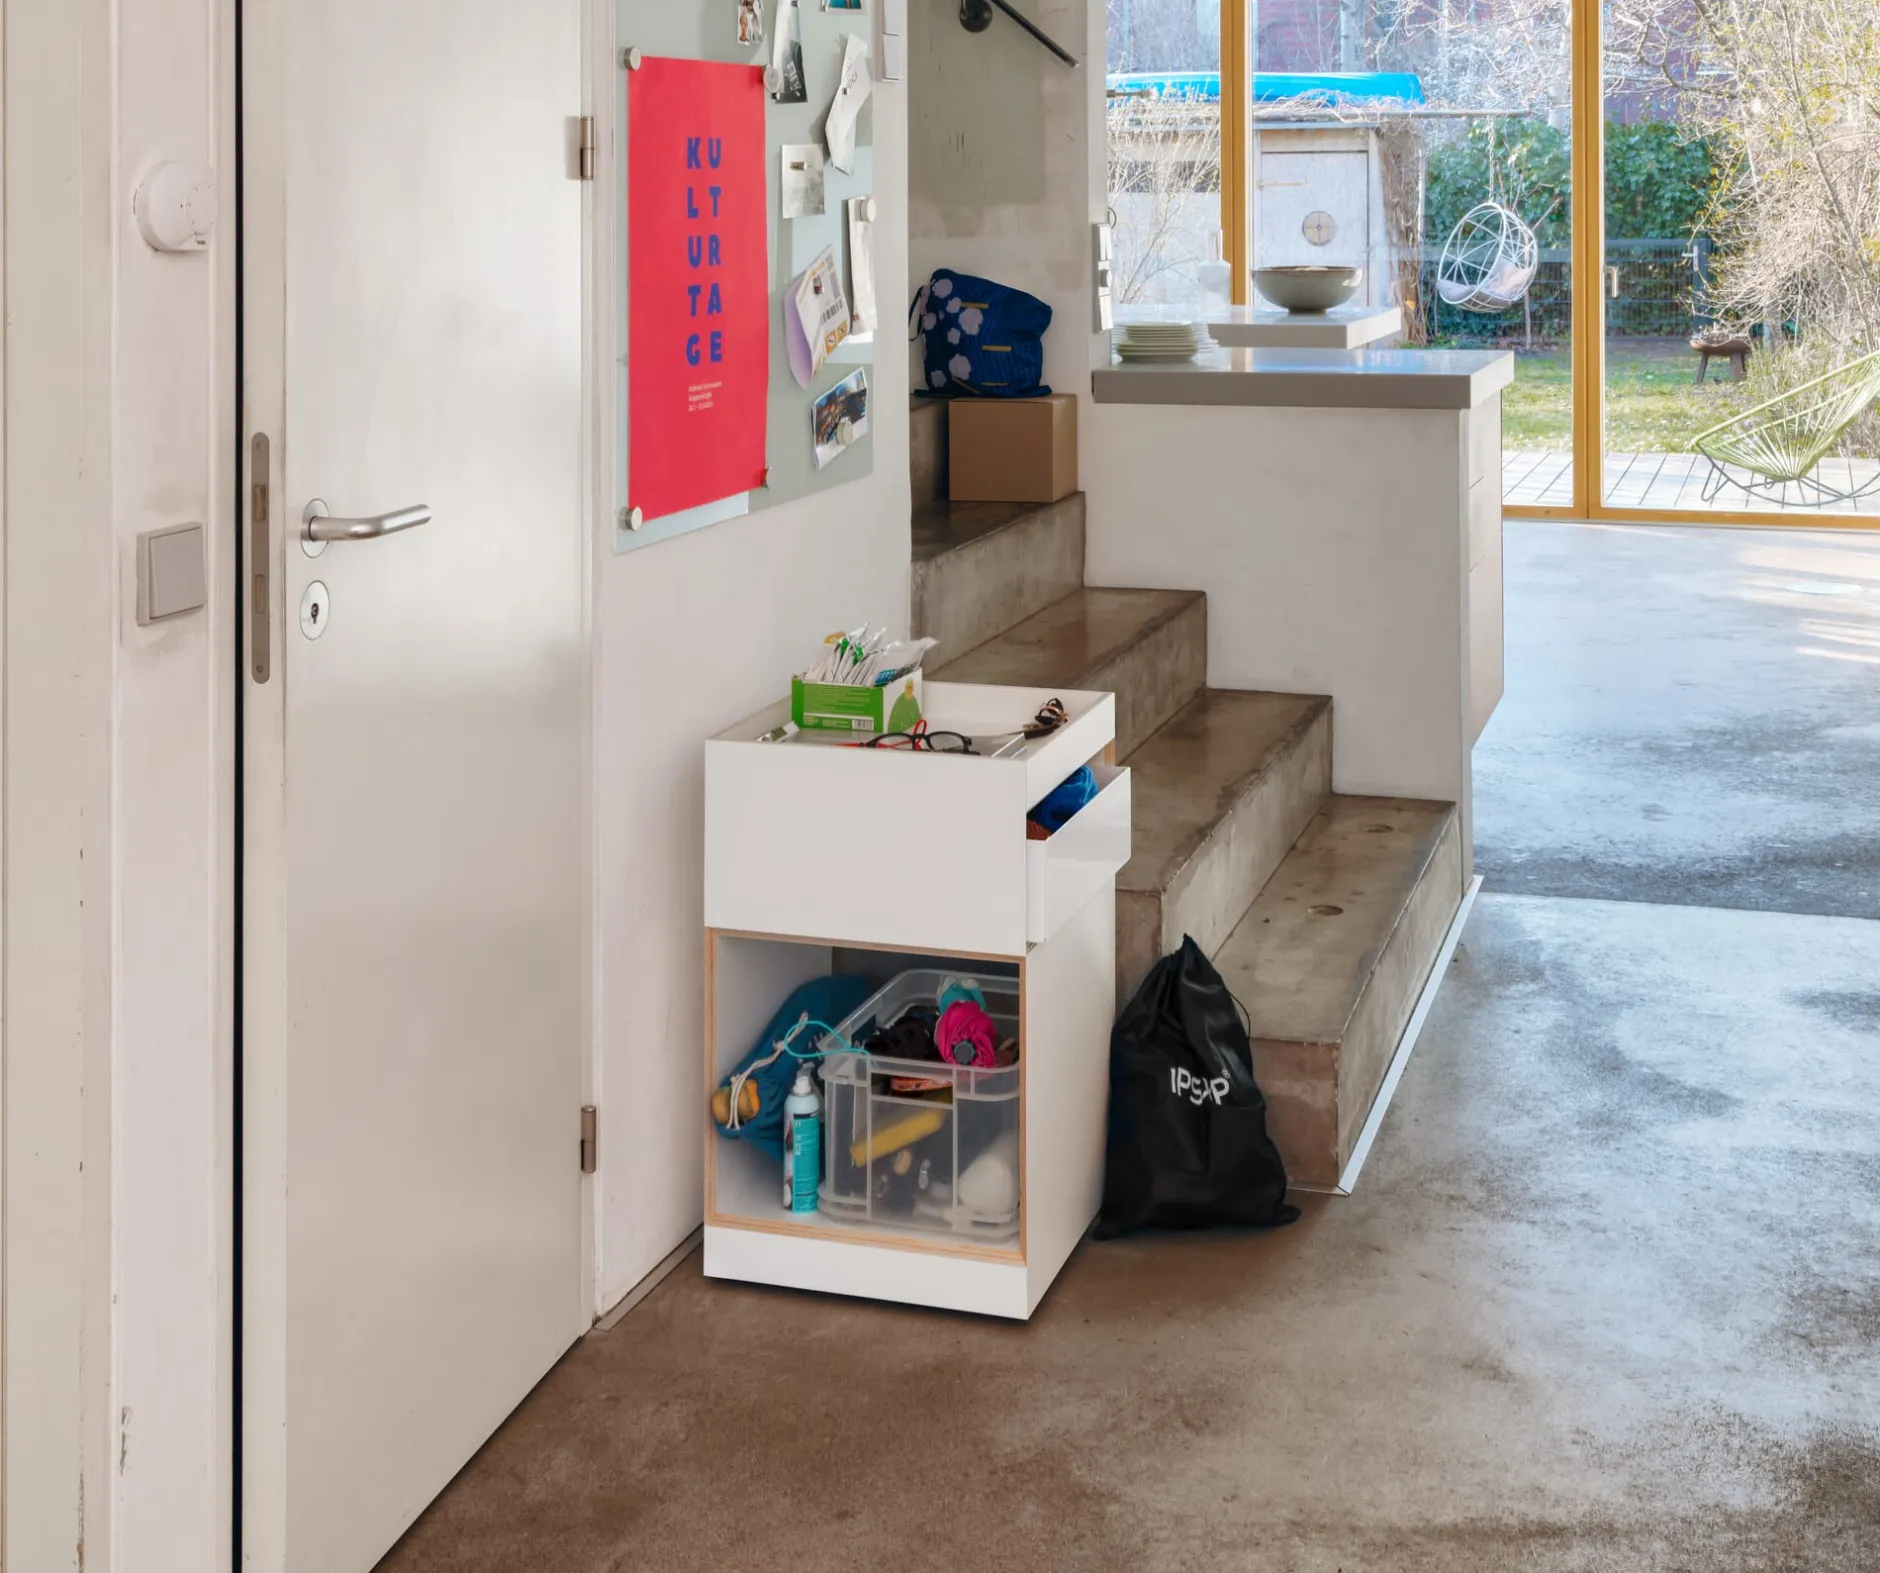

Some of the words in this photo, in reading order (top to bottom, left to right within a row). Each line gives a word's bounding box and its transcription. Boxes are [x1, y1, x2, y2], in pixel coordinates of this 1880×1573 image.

[686, 136, 722, 170] KU
[686, 185, 722, 219] LT
[687, 233, 722, 268] UR
[686, 281, 722, 317] TA
[685, 330, 723, 367] GE
